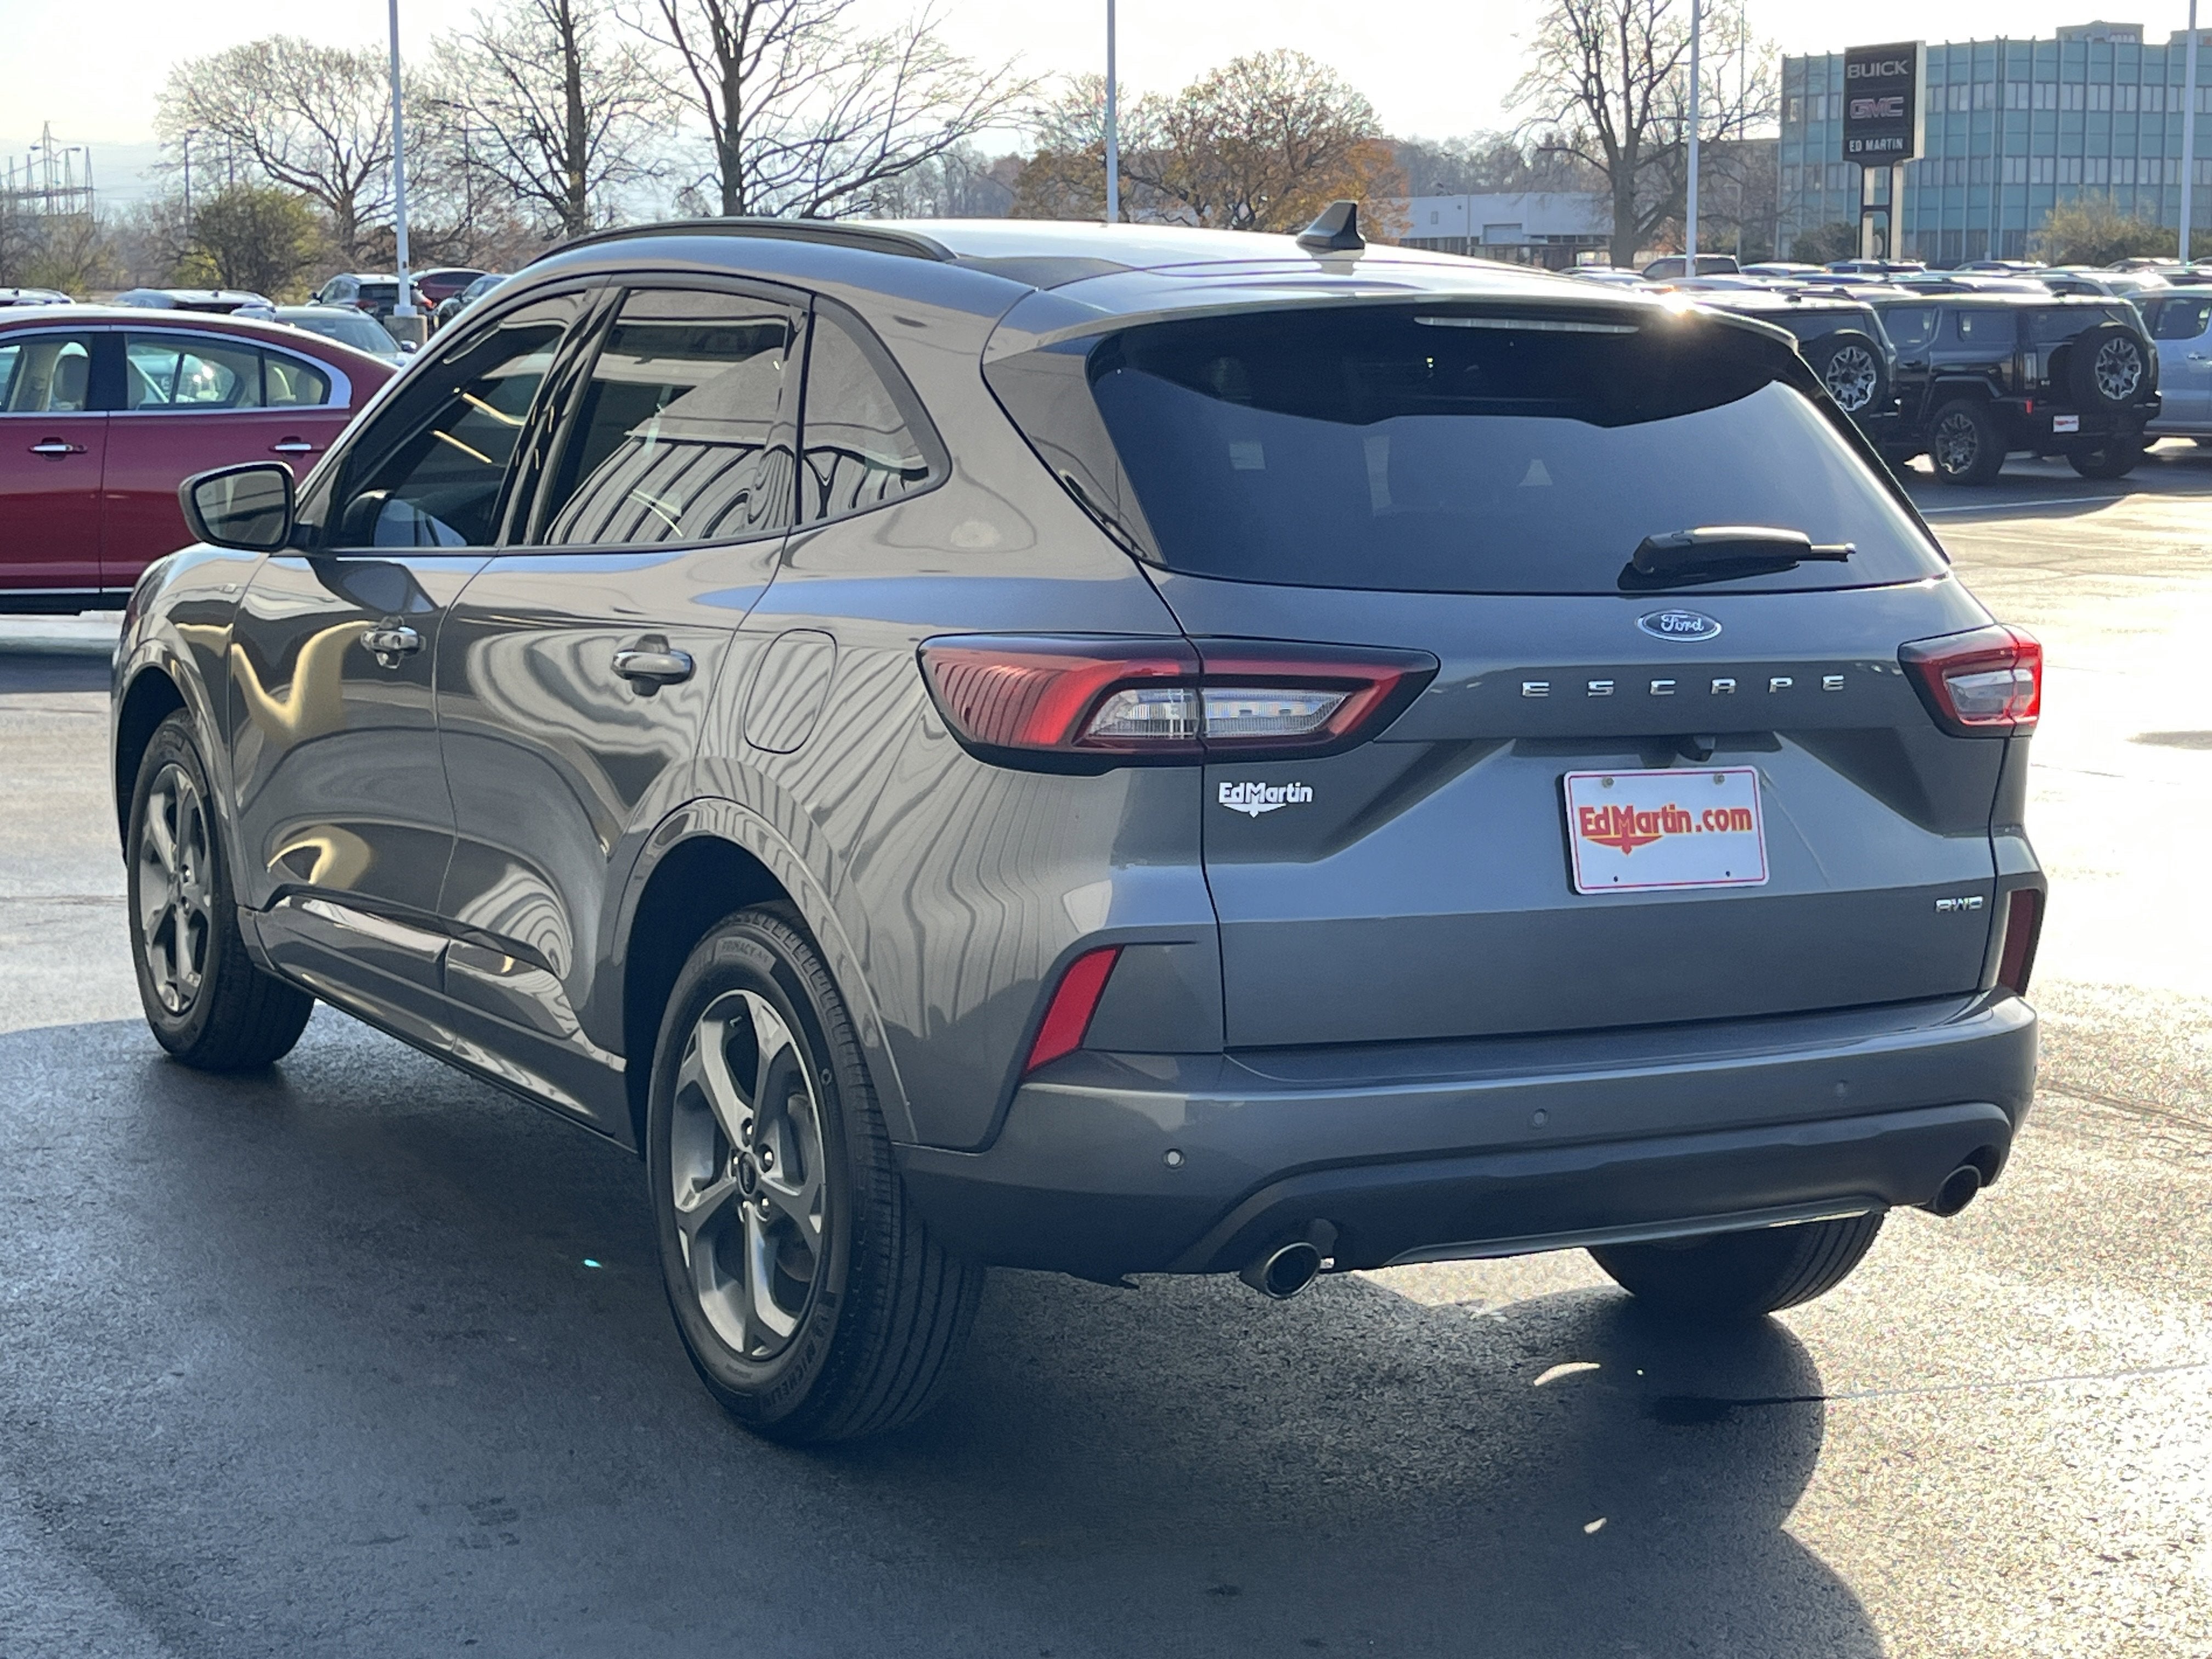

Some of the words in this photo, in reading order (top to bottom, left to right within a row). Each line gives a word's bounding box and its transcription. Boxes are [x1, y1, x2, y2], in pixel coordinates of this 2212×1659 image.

[1847, 60, 1909, 78] BUICK
[1850, 97, 1904, 119] GMC
[1849, 140, 1863, 153] ED
[1866, 138, 1903, 151] MARTIN
[1661, 614, 1705, 631] Ford
[1521, 675, 1845, 697] ESCAPE
[1218, 782, 1314, 804] EdMartin
[1579, 803, 1752, 837] EdMartin.com
